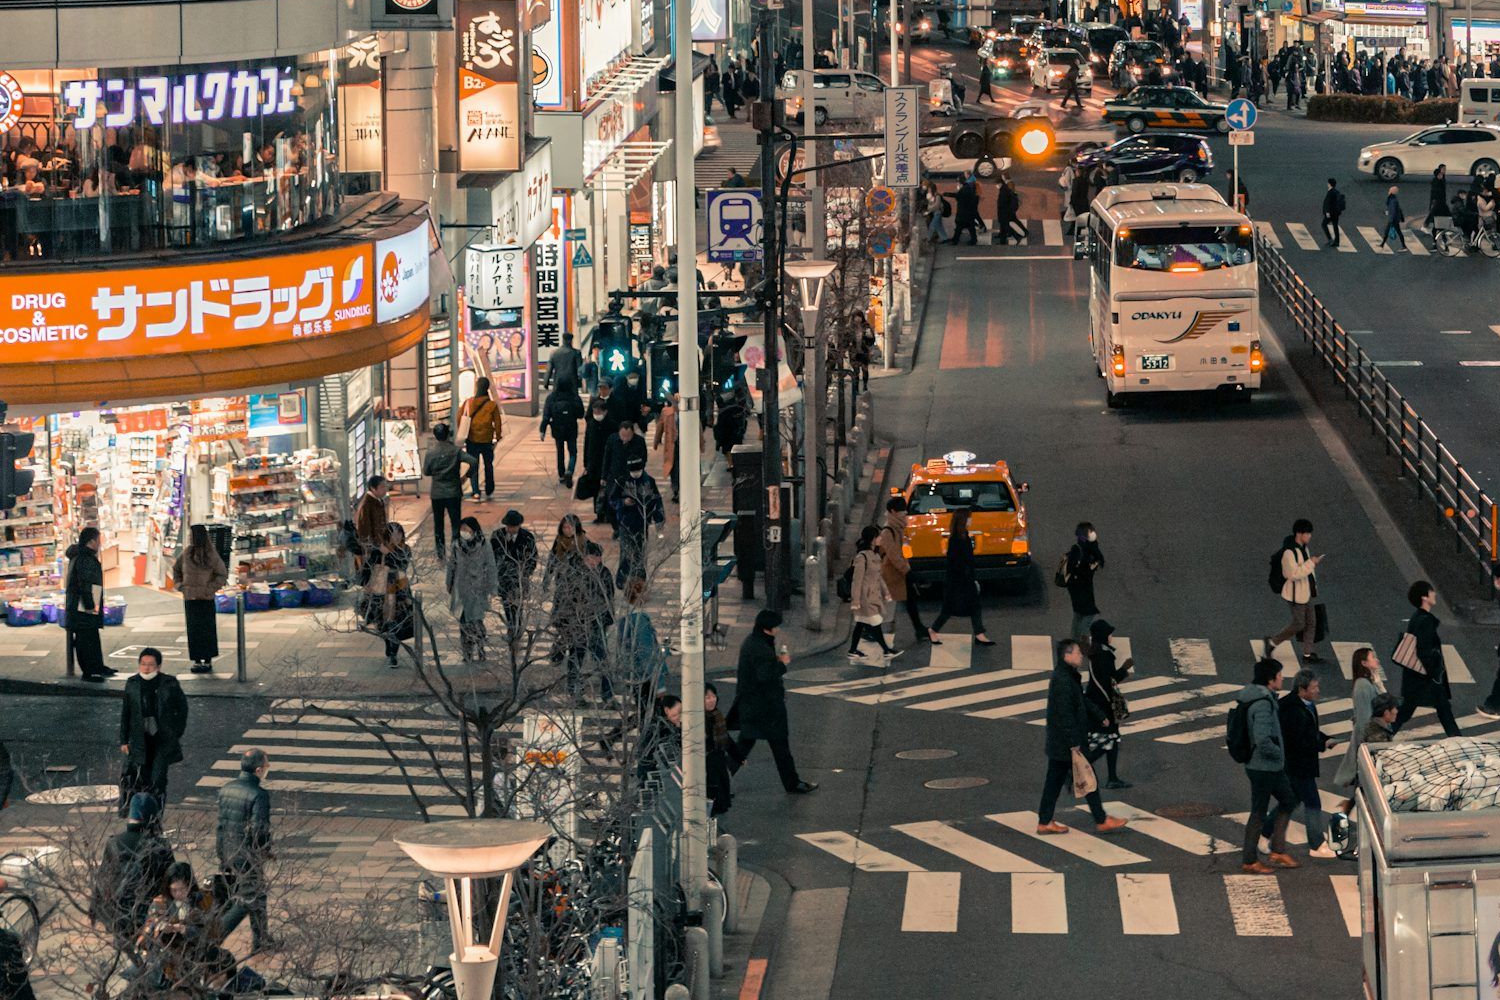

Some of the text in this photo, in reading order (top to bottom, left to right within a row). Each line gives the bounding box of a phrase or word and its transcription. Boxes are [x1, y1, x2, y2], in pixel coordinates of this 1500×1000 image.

[471, 10, 515, 69] すごろく
[463, 76, 486, 90] B2F
[65, 65, 295, 130] サンマルクカフェ
[894, 91, 909, 183] スクランブル交差点
[492, 253, 503, 306] ルノアール
[11, 292, 66, 310] DRUG
[91, 266, 335, 341] サンドラッグ
[31, 309, 46, 325] &
[333, 303, 372, 322] SUNDRUG
[1131, 311, 1182, 321] ODAKYU
[1199, 356, 1228, 365] 小田急
